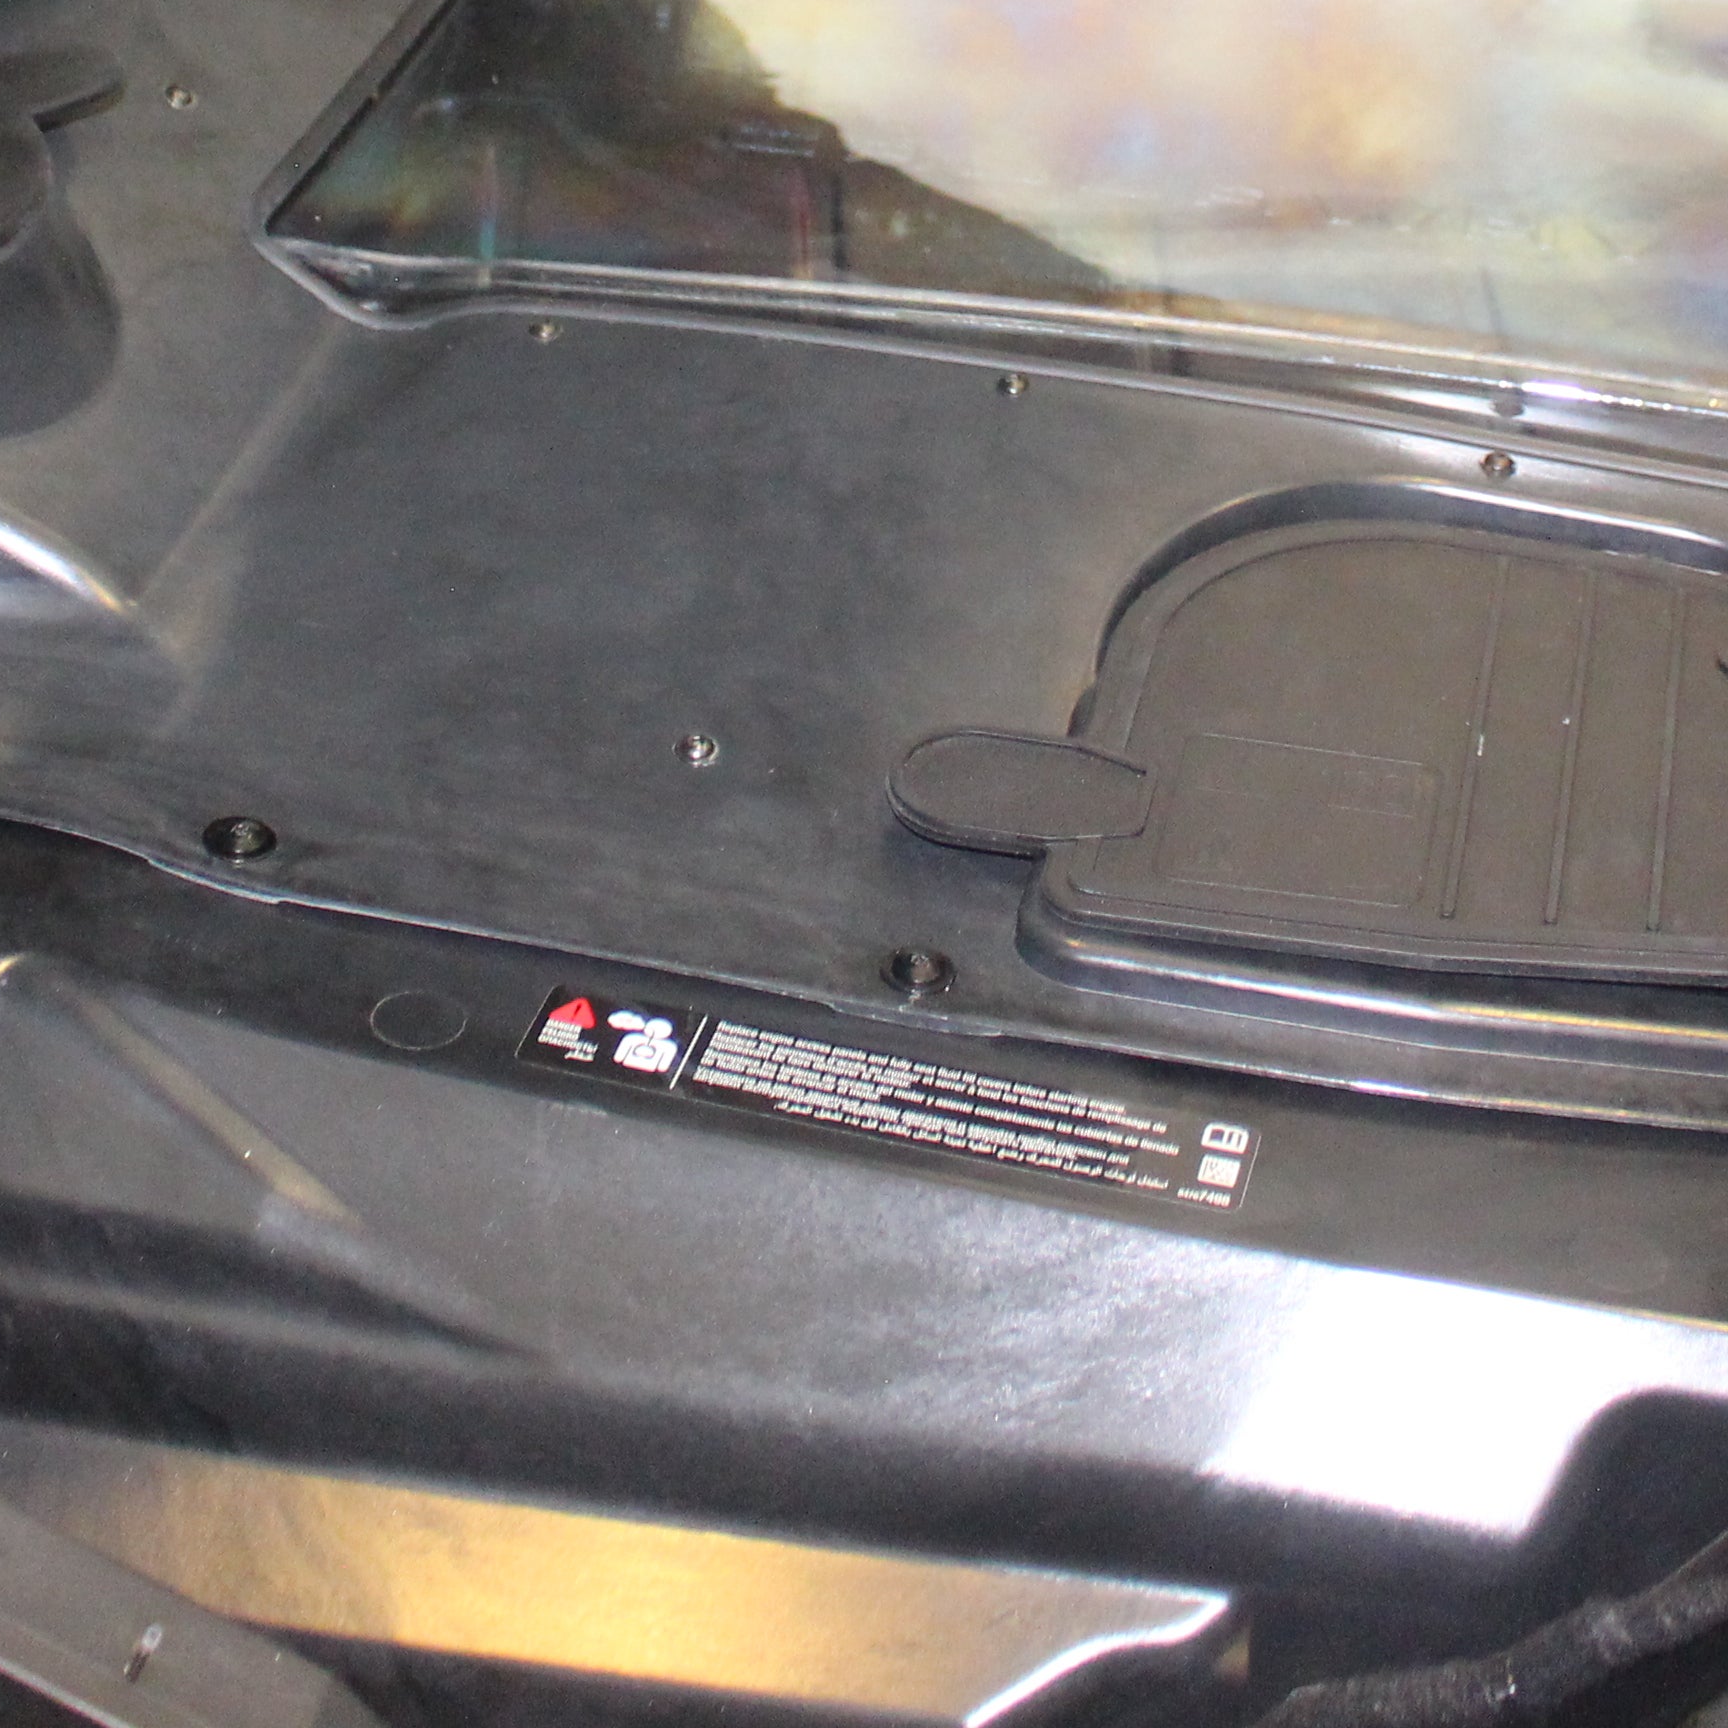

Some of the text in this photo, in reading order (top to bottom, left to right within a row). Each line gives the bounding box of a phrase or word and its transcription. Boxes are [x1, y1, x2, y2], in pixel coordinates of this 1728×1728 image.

[718, 1021, 757, 1037] Replace
[759, 1030, 793, 1045] engine
[795, 1038, 829, 1051] access
[833, 1045, 866, 1060] panels
[868, 1052, 888, 1063] and
[890, 1057, 912, 1069] fully
[914, 1062, 935, 1073] seat
[978, 1076, 1011, 1089] covers
[1014, 1082, 1047, 1096] before
[1048, 1090, 1088, 1106] starting
[894, 1087, 925, 1102] motor
[926, 1095, 934, 1104] y
[974, 1103, 1056, 1129] completamente
[1056, 1120, 1074, 1132] las
[1074, 1123, 1125, 1143] cubiertas
[1124, 1134, 1140, 1146] de
[1140, 1137, 1180, 1154] llenado
[922, 1073, 934, 1084] et
[935, 1077, 966, 1091] serrer
[977, 1085, 1002, 1098] fond
[1003, 1090, 1019, 1101] les
[1020, 1093, 1071, 1112] bouchons
[1072, 1104, 1087, 1115] de
[1087, 1107, 1152, 1130] remplissage
[1152, 1120, 1168, 1132] de
